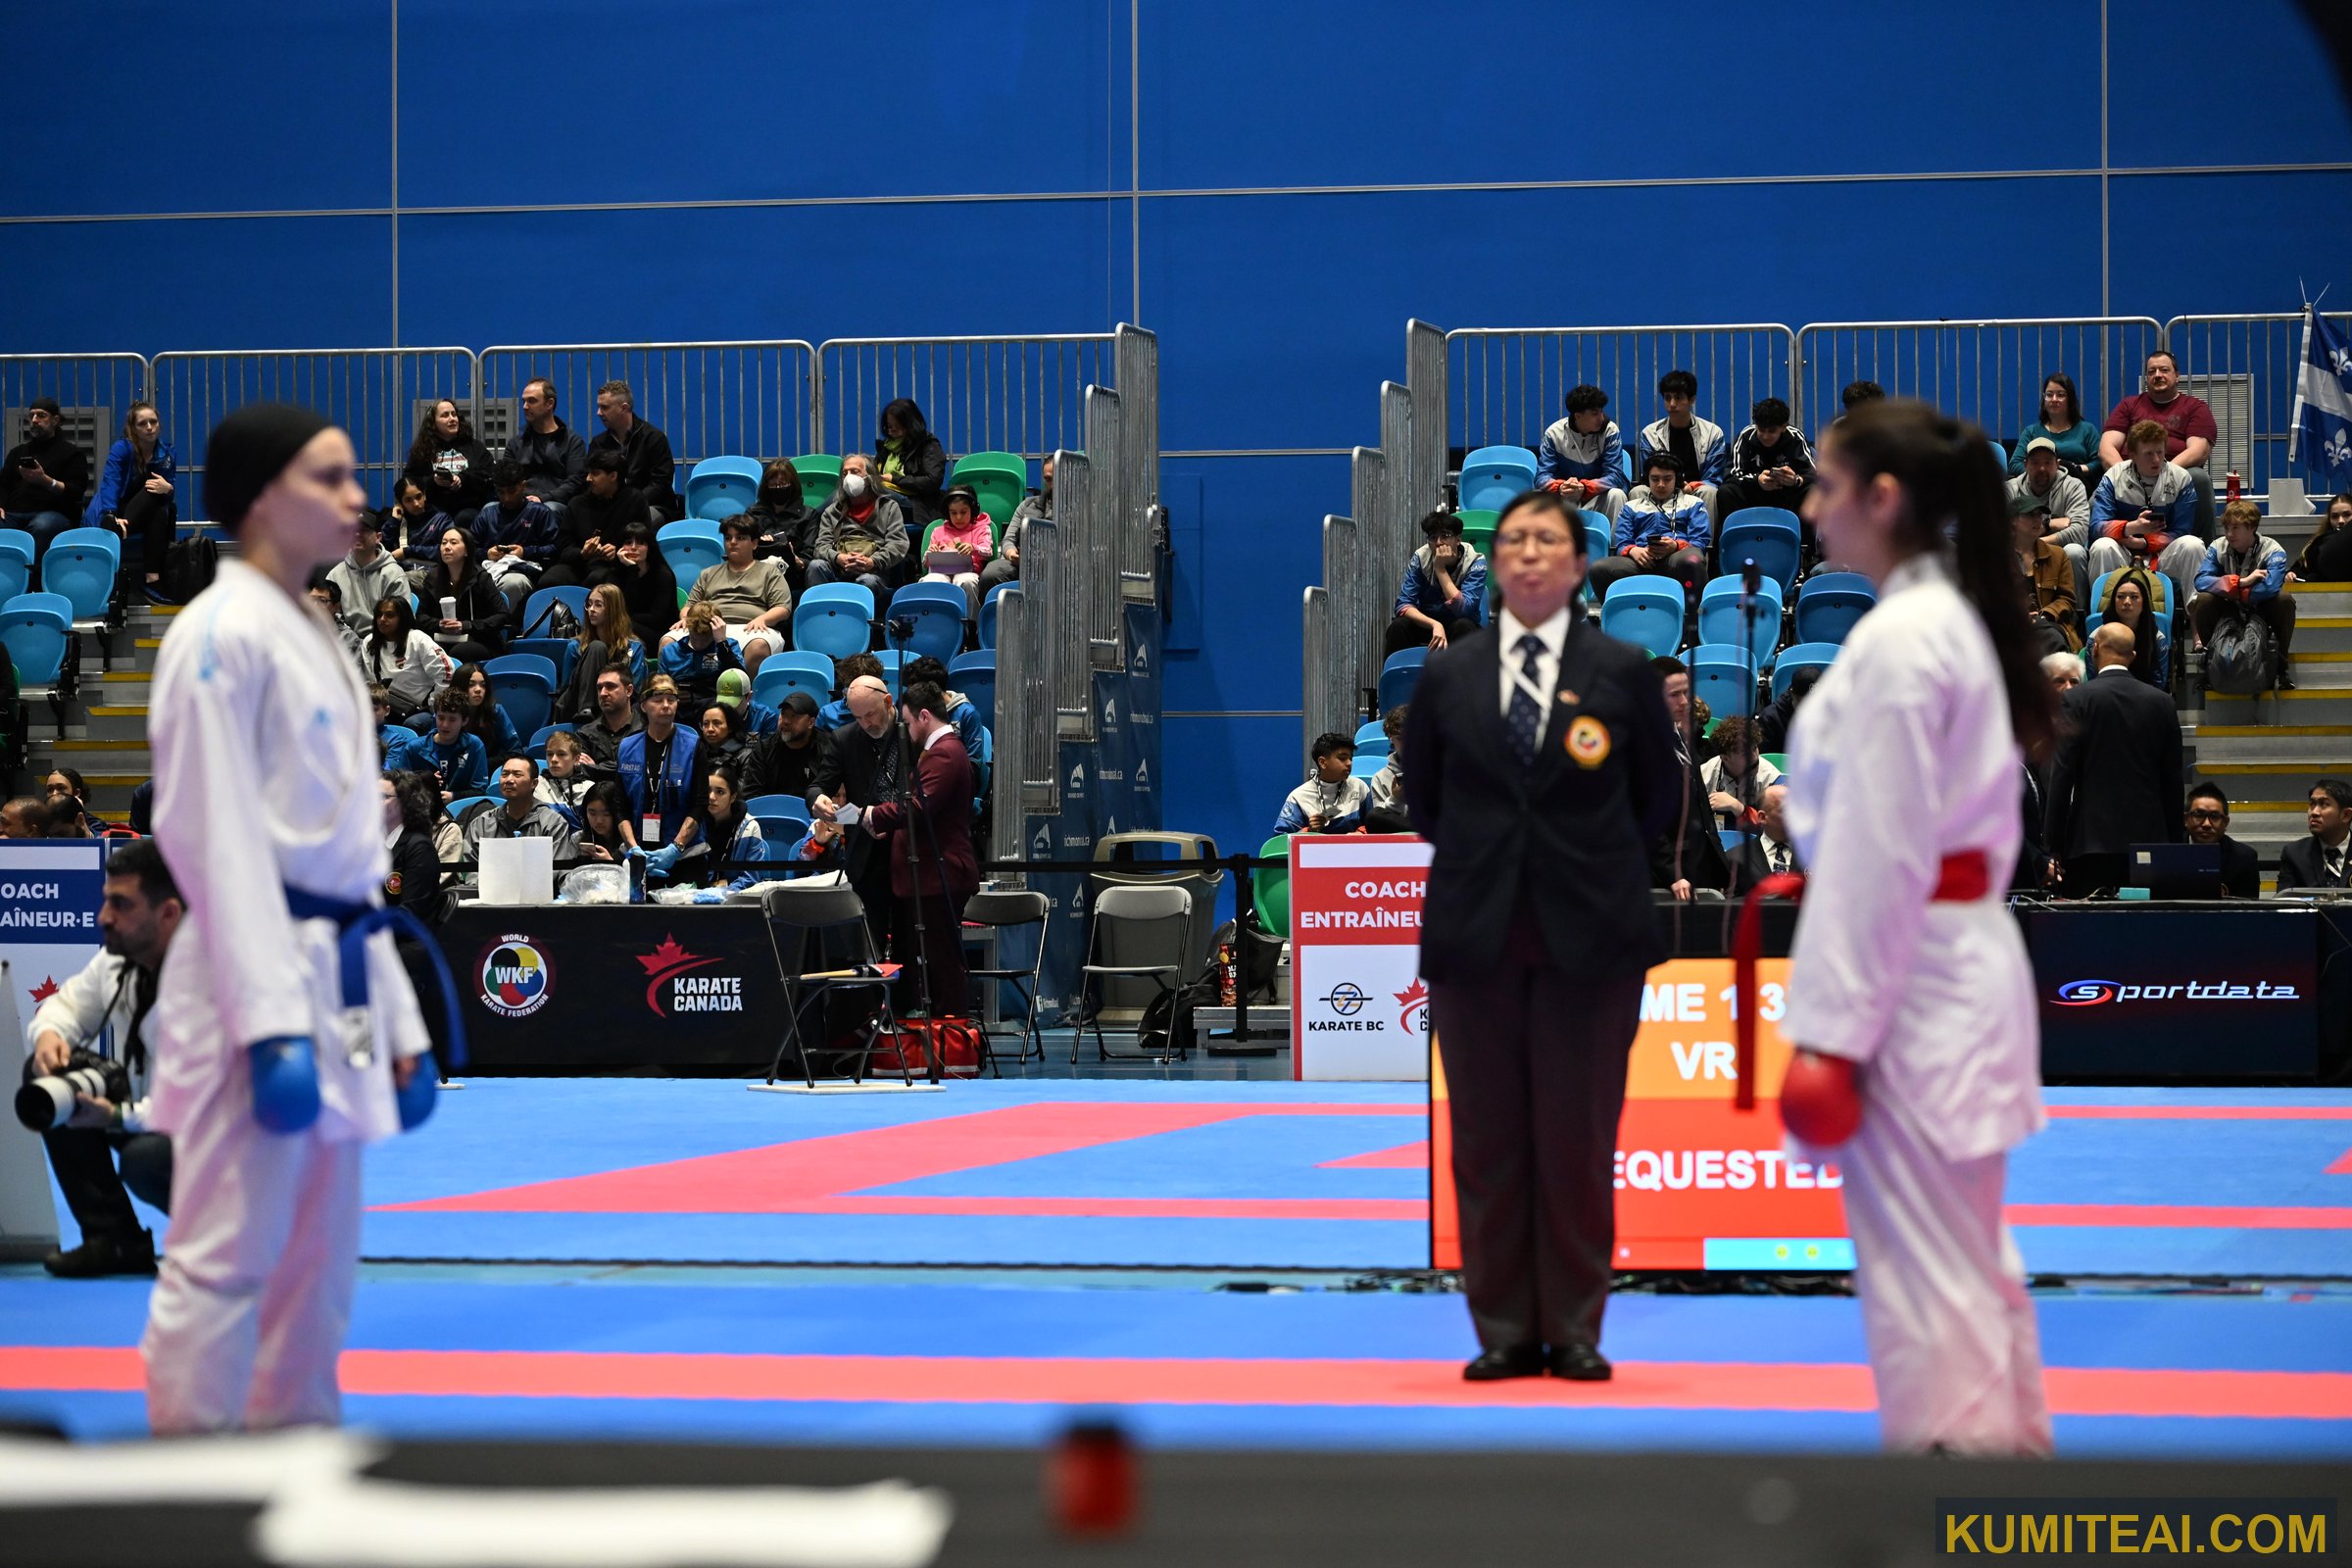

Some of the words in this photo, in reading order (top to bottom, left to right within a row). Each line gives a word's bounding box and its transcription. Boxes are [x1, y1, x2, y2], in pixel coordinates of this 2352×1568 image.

[0, 883, 59, 899] OACH
[1345, 881, 1427, 899] COACH
[501, 934, 529, 943] WORLD
[494, 966, 534, 984] WKF
[674, 977, 742, 995] KARATE
[480, 993, 506, 1016] KARATE
[507, 993, 550, 1017] FEDERATION
[673, 995, 743, 1011] CANADA
[1308, 1020, 1363, 1032] KARATE
[1366, 1020, 1385, 1032] BC
[1670, 1041, 1739, 1080] VR
